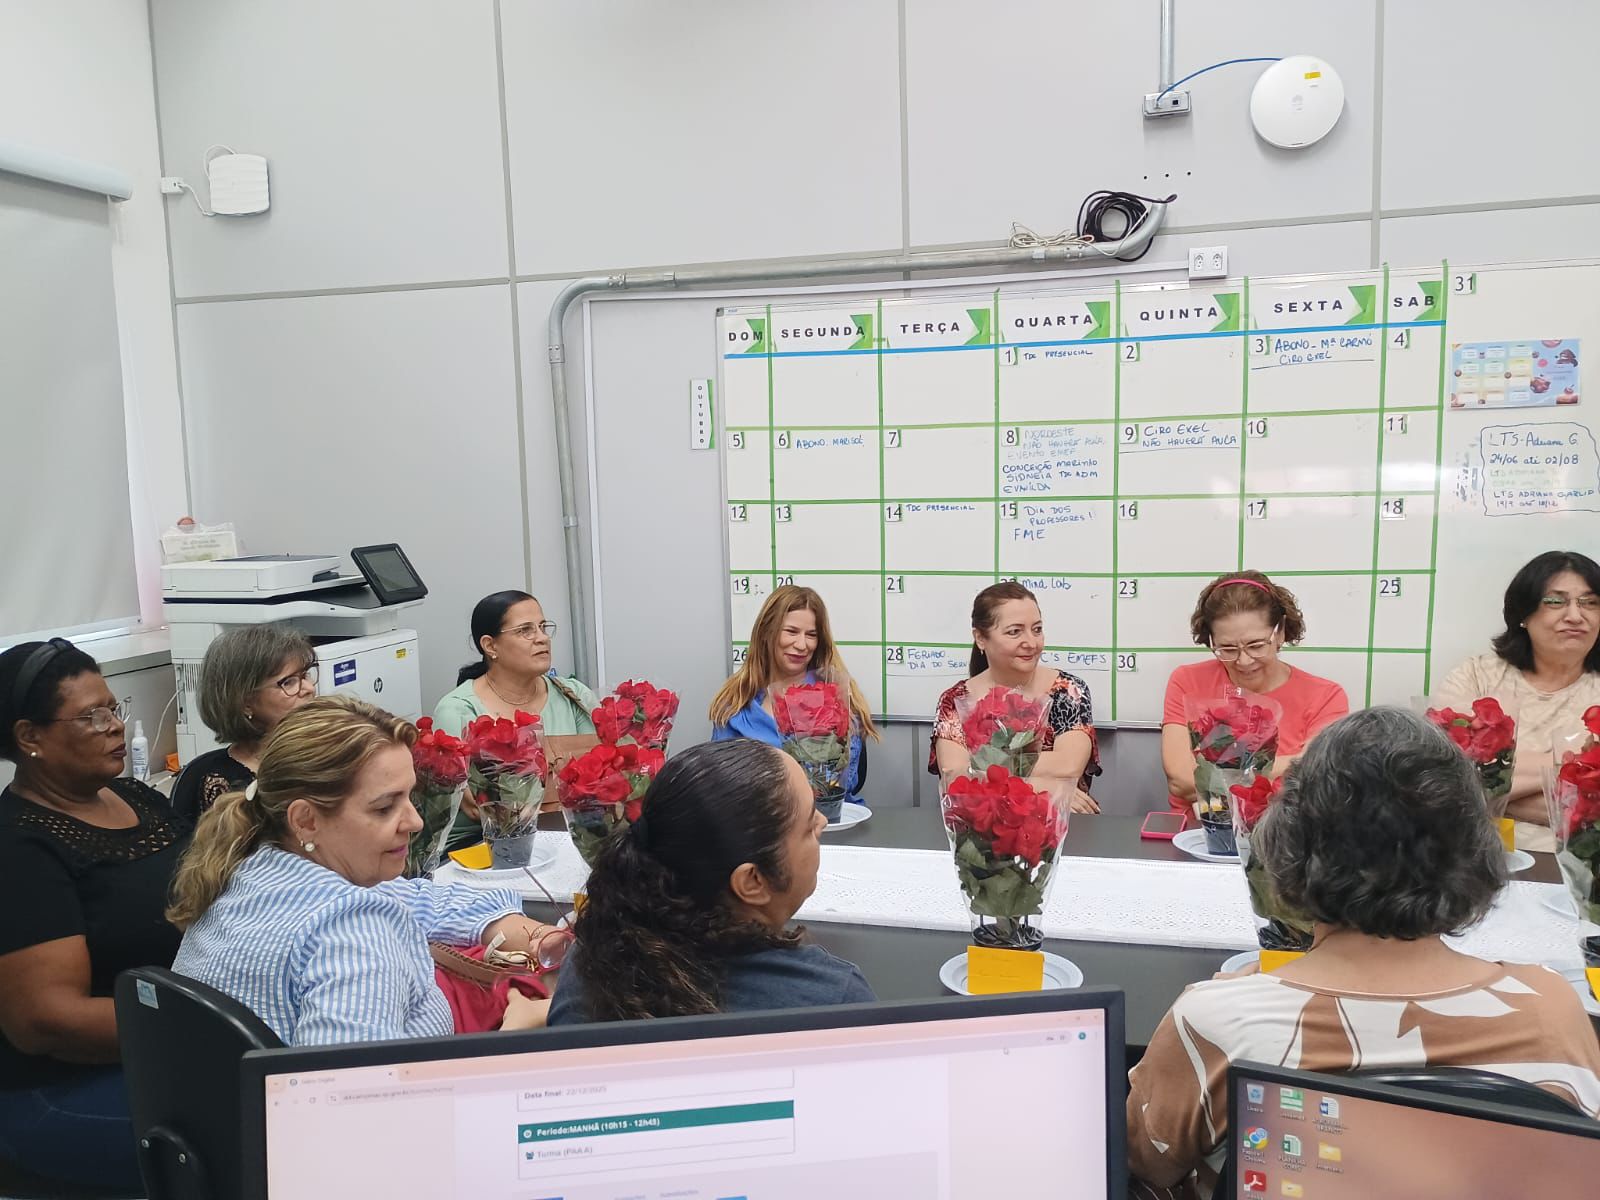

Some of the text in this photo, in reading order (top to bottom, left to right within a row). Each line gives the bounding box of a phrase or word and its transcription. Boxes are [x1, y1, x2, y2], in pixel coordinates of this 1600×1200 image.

[1455, 275, 1474, 292] 31
[1273, 299, 1343, 313] SEXTA
[1393, 295, 1435, 308] SAB
[1140, 306, 1218, 321] QUINTA
[900, 321, 960, 335] TERÇA
[1014, 314, 1093, 328] QUARTA
[728, 331, 763, 342] DOM
[781, 325, 865, 338] SEGUNDA
[1255, 338, 1264, 353] 3
[1274, 338, 1309, 353] ABONO
[1394, 332, 1404, 346] 4
[1005, 349, 1011, 363] 1
[1045, 349, 1093, 358] PRESENCIAL
[1126, 345, 1135, 359] 2
[697, 385, 705, 444] OUTUBRO
[1247, 420, 1266, 435] 10
[1386, 416, 1405, 431] 11
[888, 431, 897, 445] 7
[1006, 430, 1015, 444] 8
[1125, 426, 1134, 441] 9
[1144, 425, 1171, 437] CIRO
[733, 433, 741, 447] 5
[778, 433, 786, 447] 6
[731, 505, 746, 519] 12
[776, 506, 791, 519] 13
[886, 504, 902, 519] 14
[905, 503, 975, 512] TDC PRESENCIAL
[1000, 503, 1017, 517] 15
[1119, 503, 1137, 518] 16
[1248, 501, 1266, 516] 17
[1383, 499, 1403, 515] 18
[1014, 527, 1046, 541] FME
[734, 578, 749, 592] 19
[887, 577, 903, 591] 21
[1119, 580, 1137, 595] 23
[1379, 578, 1400, 594] 25
[887, 647, 904, 661] 28
[1118, 654, 1136, 669] 30
